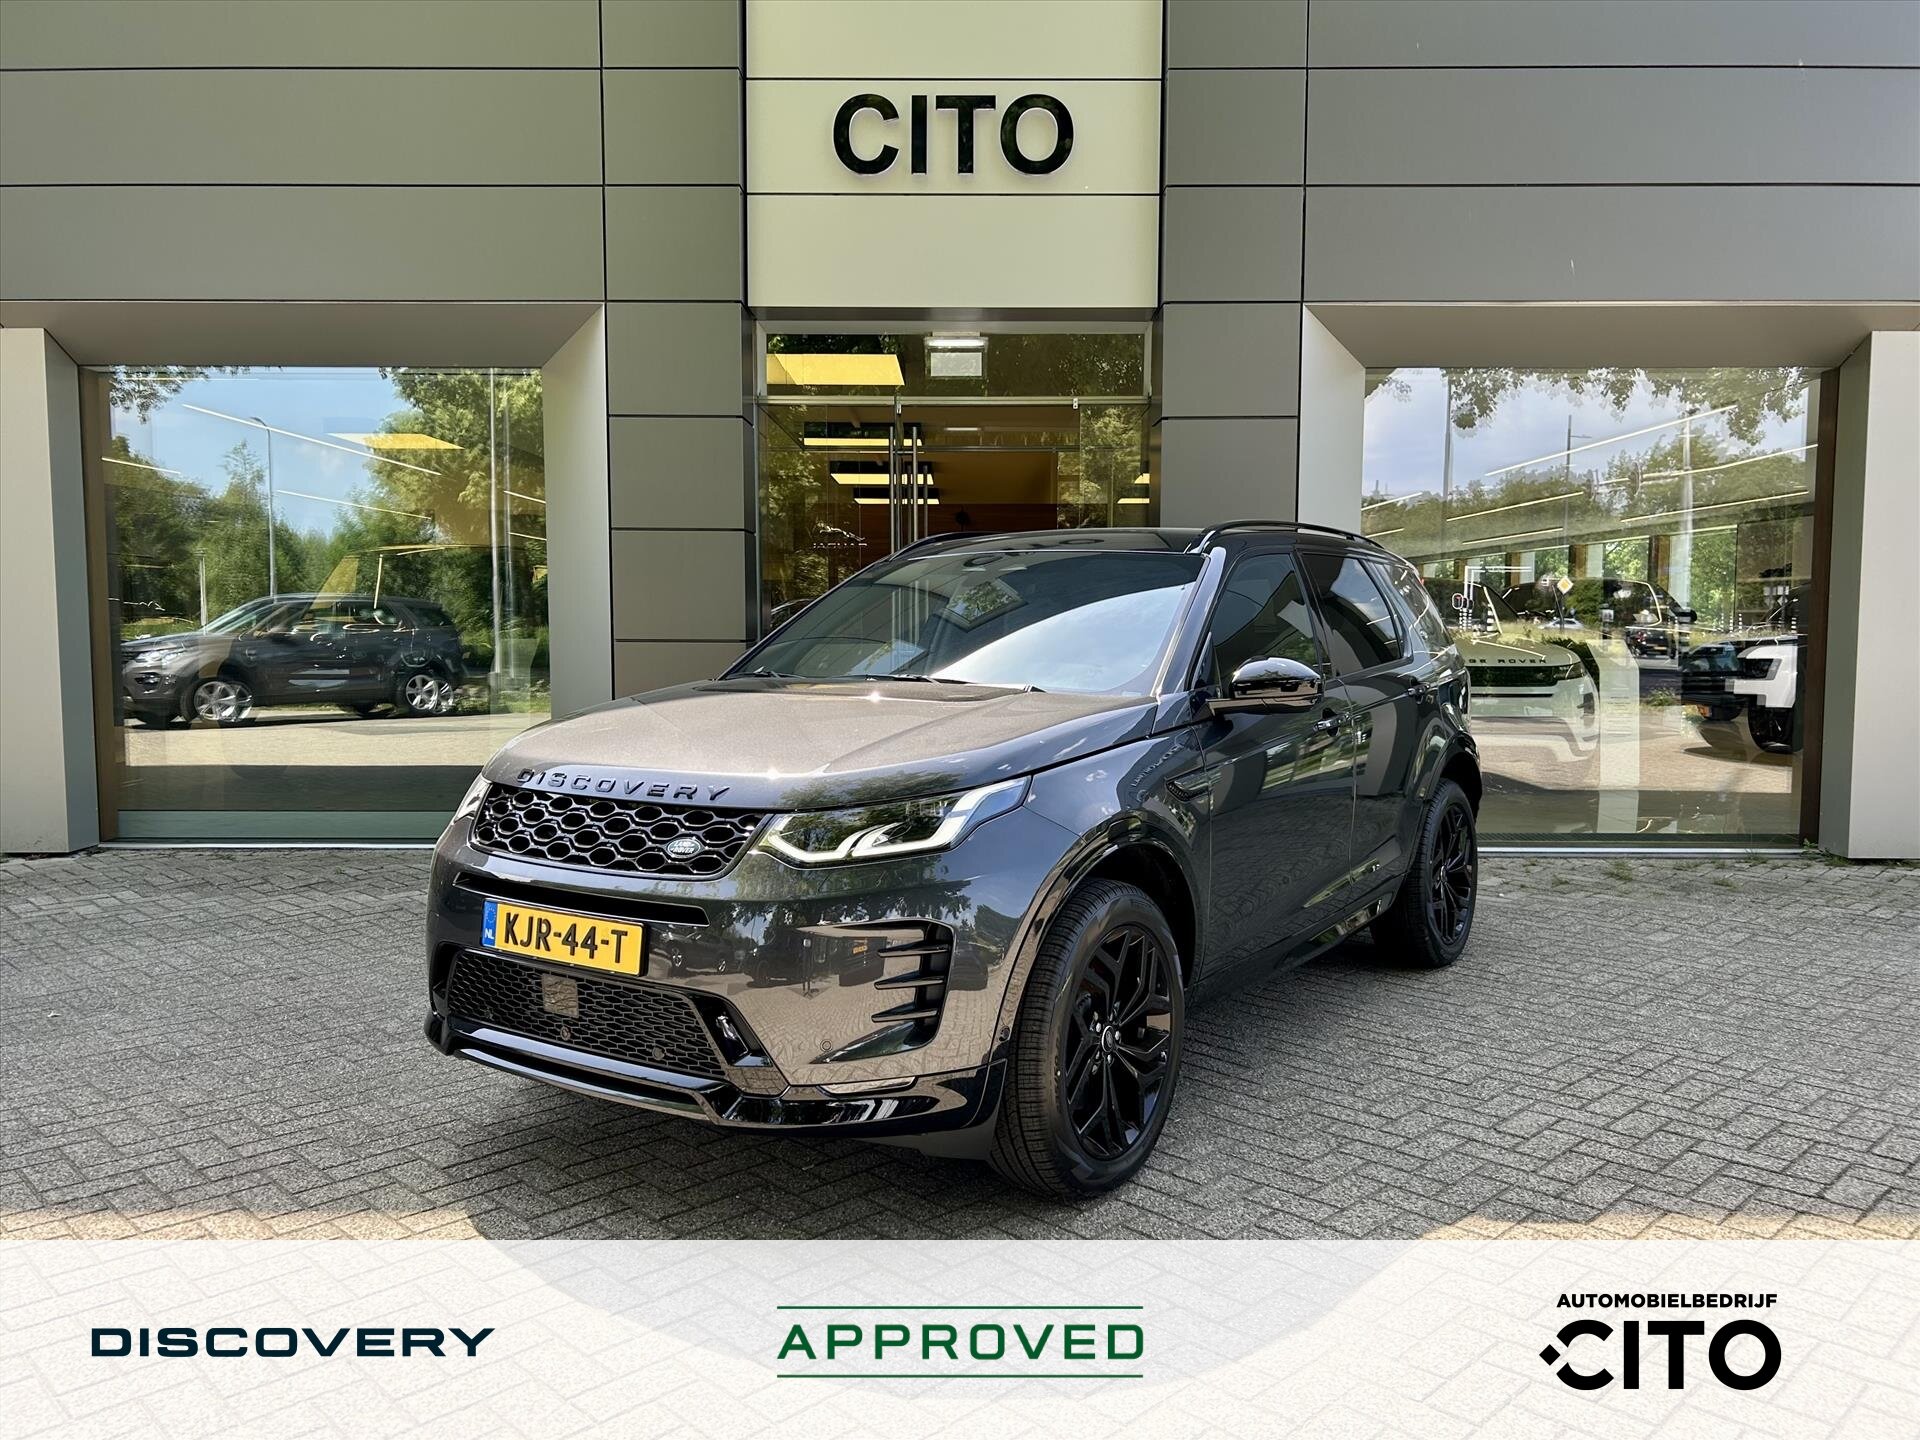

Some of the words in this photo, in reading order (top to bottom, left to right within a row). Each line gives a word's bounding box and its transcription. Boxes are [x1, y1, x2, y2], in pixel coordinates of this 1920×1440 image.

[833, 93, 1074, 175] CITO
[516, 768, 730, 801] DISCOVERY
[484, 930, 495, 940] NL
[504, 912, 628, 963] KJR-44-T
